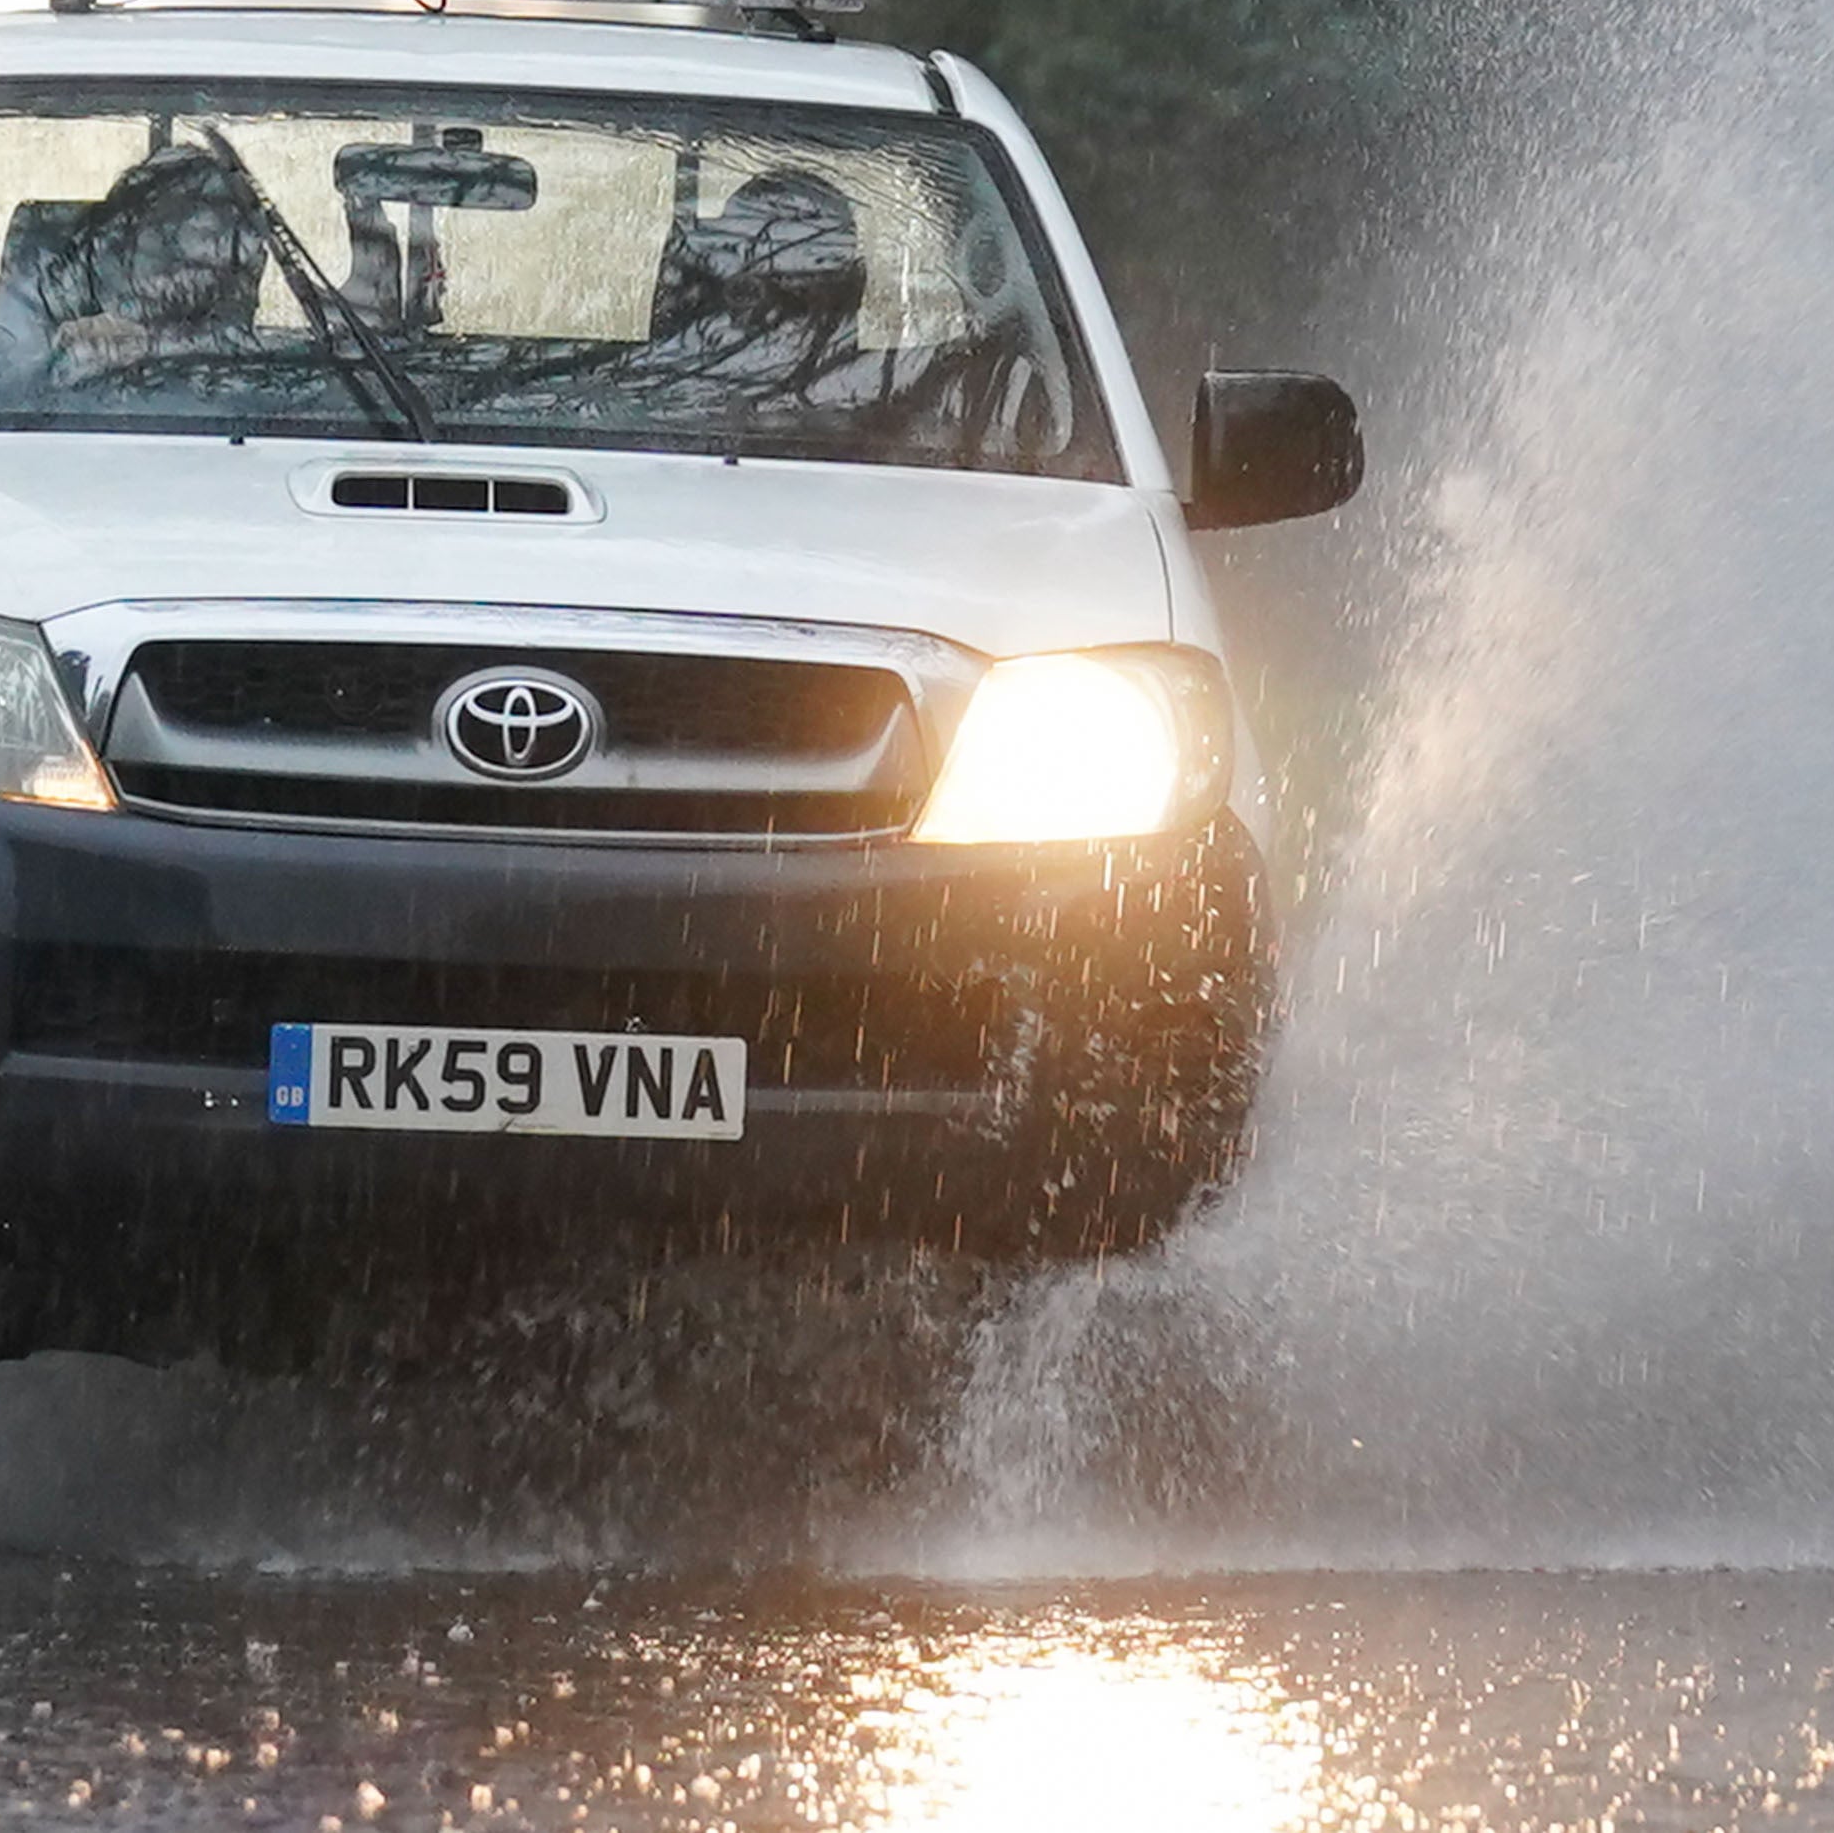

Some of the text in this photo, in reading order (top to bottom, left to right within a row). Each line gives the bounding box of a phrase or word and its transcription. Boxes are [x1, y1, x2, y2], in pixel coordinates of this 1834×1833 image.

[276, 1085, 304, 1106] GB
[328, 1036, 726, 1121] RK59 VNA
